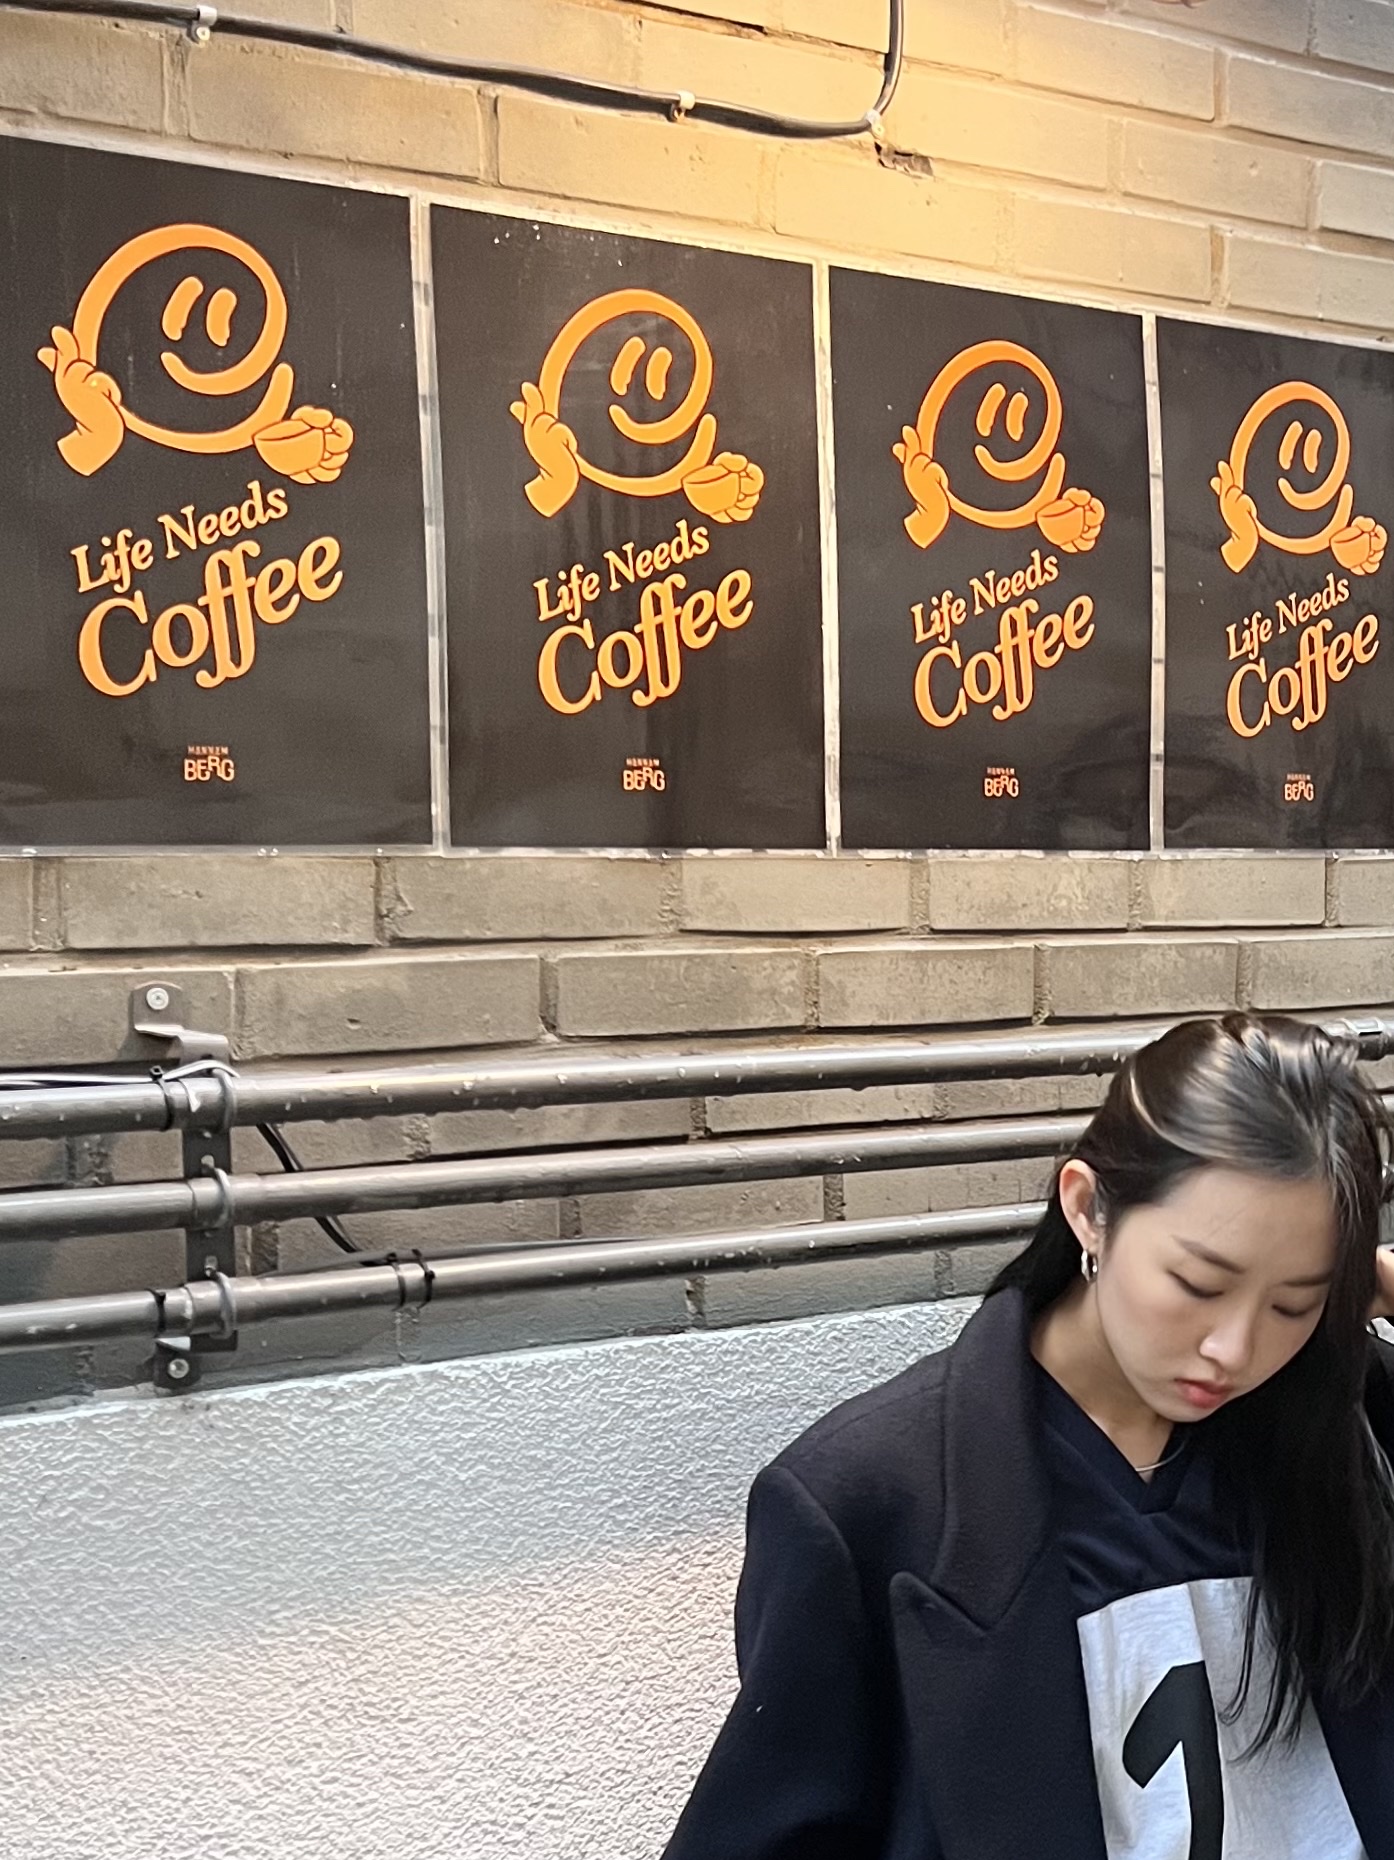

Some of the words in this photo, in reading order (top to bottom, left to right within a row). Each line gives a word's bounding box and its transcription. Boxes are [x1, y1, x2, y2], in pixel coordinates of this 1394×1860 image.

[70, 529, 153, 593] Life
[157, 480, 289, 560] Needs
[533, 563, 601, 622] Life
[603, 518, 710, 592] Needs
[78, 535, 344, 697] Coffee
[537, 568, 754, 715] Coffee
[910, 589, 968, 644] Life
[968, 548, 1060, 616] Needs
[1226, 611, 1273, 661] Life
[1275, 572, 1350, 634] Needs
[913, 594, 1095, 728] Coffee
[1226, 614, 1380, 738] Coffee
[184, 755, 235, 782] BERG
[623, 767, 665, 791] BERG
[984, 775, 1019, 797] BERG
[1284, 781, 1314, 801] BERG
